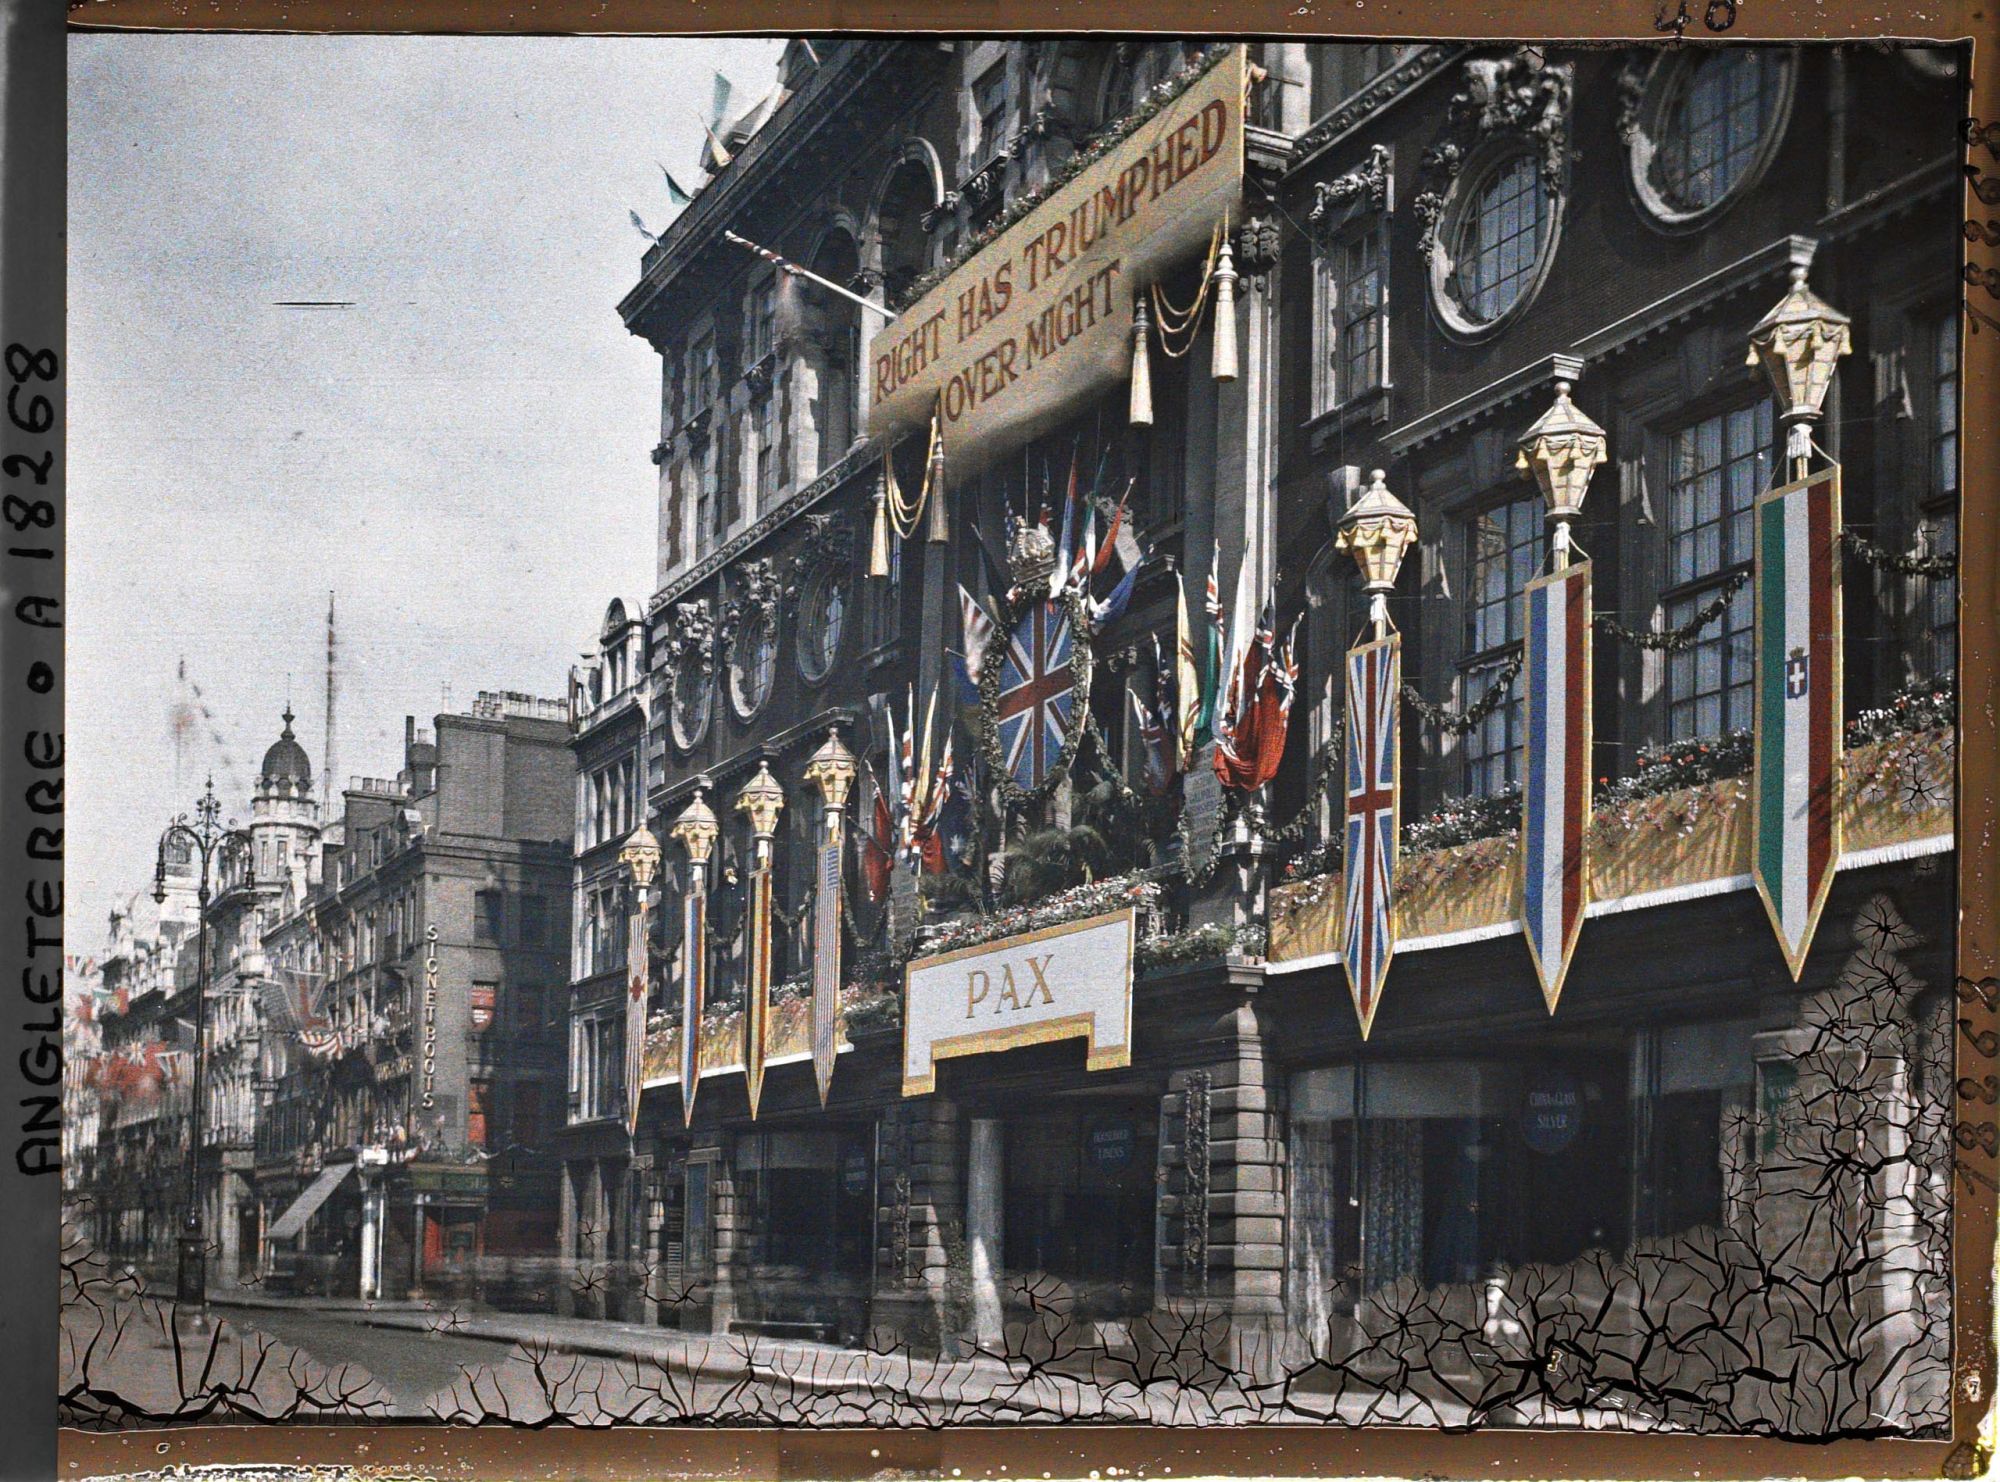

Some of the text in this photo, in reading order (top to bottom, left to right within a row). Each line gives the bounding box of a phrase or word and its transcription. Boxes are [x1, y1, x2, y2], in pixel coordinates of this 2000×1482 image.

[875, 99, 1227, 405] RIGHT HAS TRIUMPHED
[945, 259, 1122, 422] OVER MIGHT
[2, 342, 65, 1176] ANGLETERRE A 18268
[422, 1025, 437, 1108] BOOTS
[966, 953, 1056, 1019] PAX
